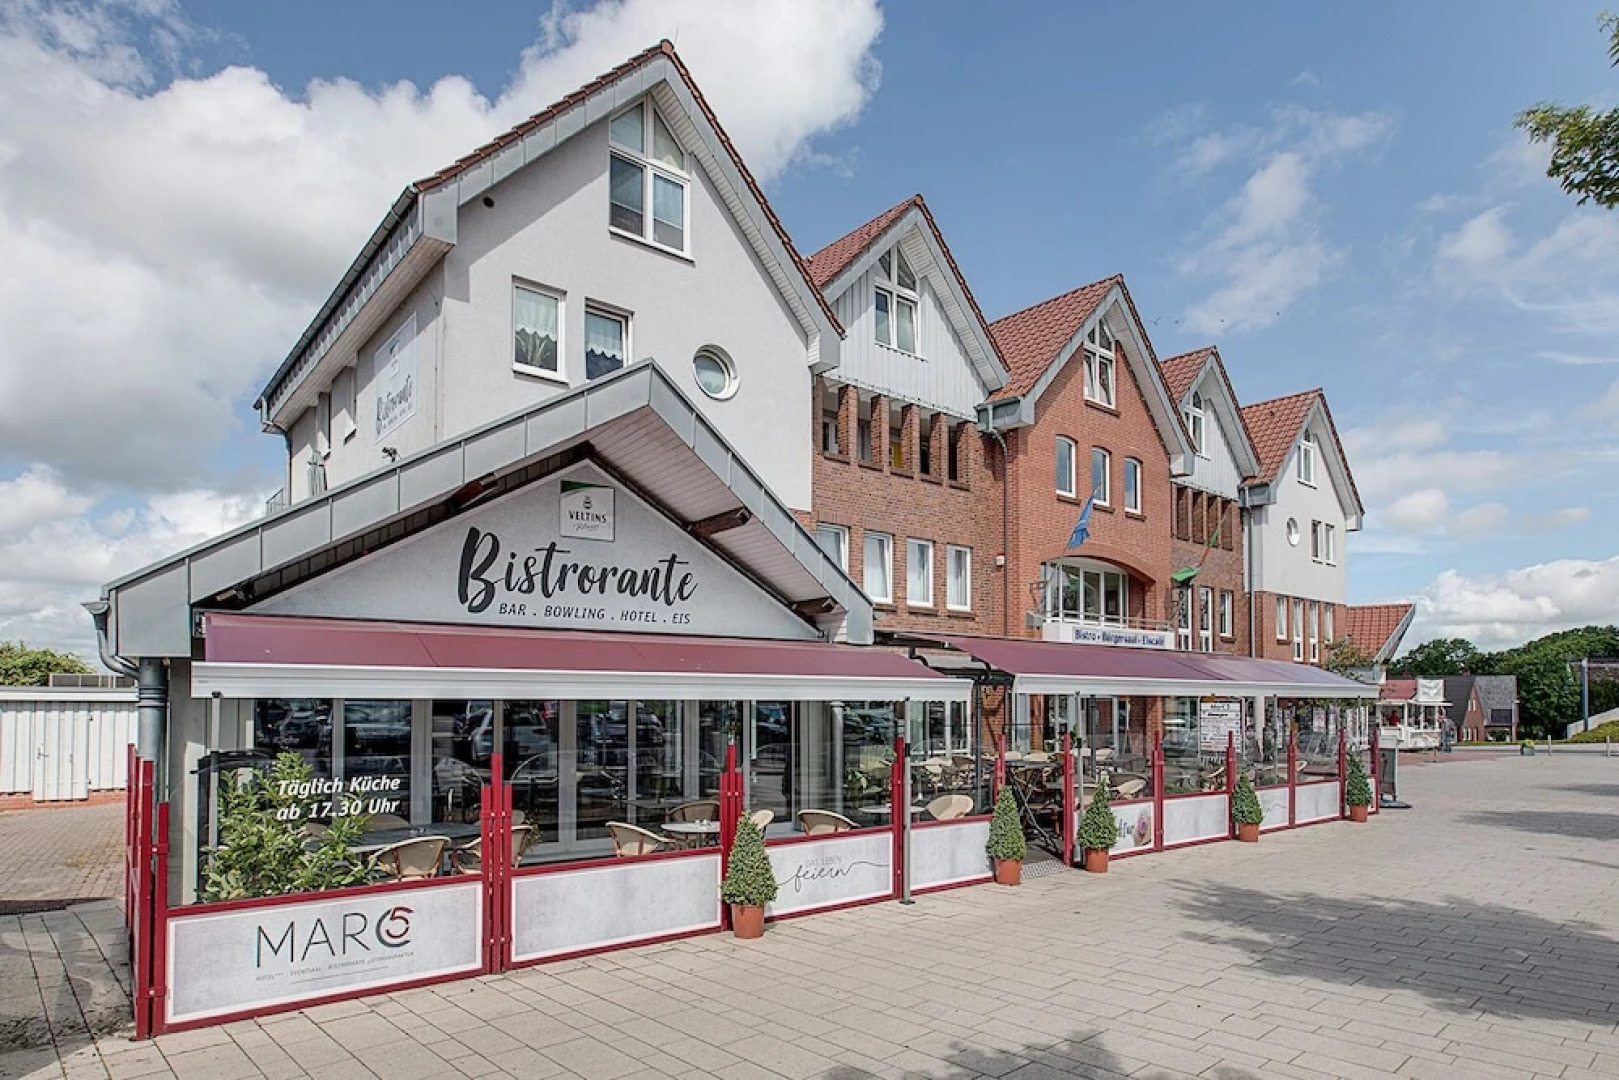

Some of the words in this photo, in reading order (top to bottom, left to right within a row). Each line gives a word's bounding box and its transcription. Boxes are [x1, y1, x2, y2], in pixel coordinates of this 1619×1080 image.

[568, 510, 607, 524] VELTINS
[458, 526, 698, 614] Bistrorante
[499, 603, 526, 616] BAR
[544, 605, 605, 621] BOWLING
[620, 610, 657, 623] HOTEL
[672, 613, 691, 625] EIS
[278, 777, 343, 798] Täglich
[350, 775, 401, 792] Küche
[276, 803, 300, 820] ab
[308, 800, 361, 818] 17.30
[368, 798, 400, 814] Uhr
